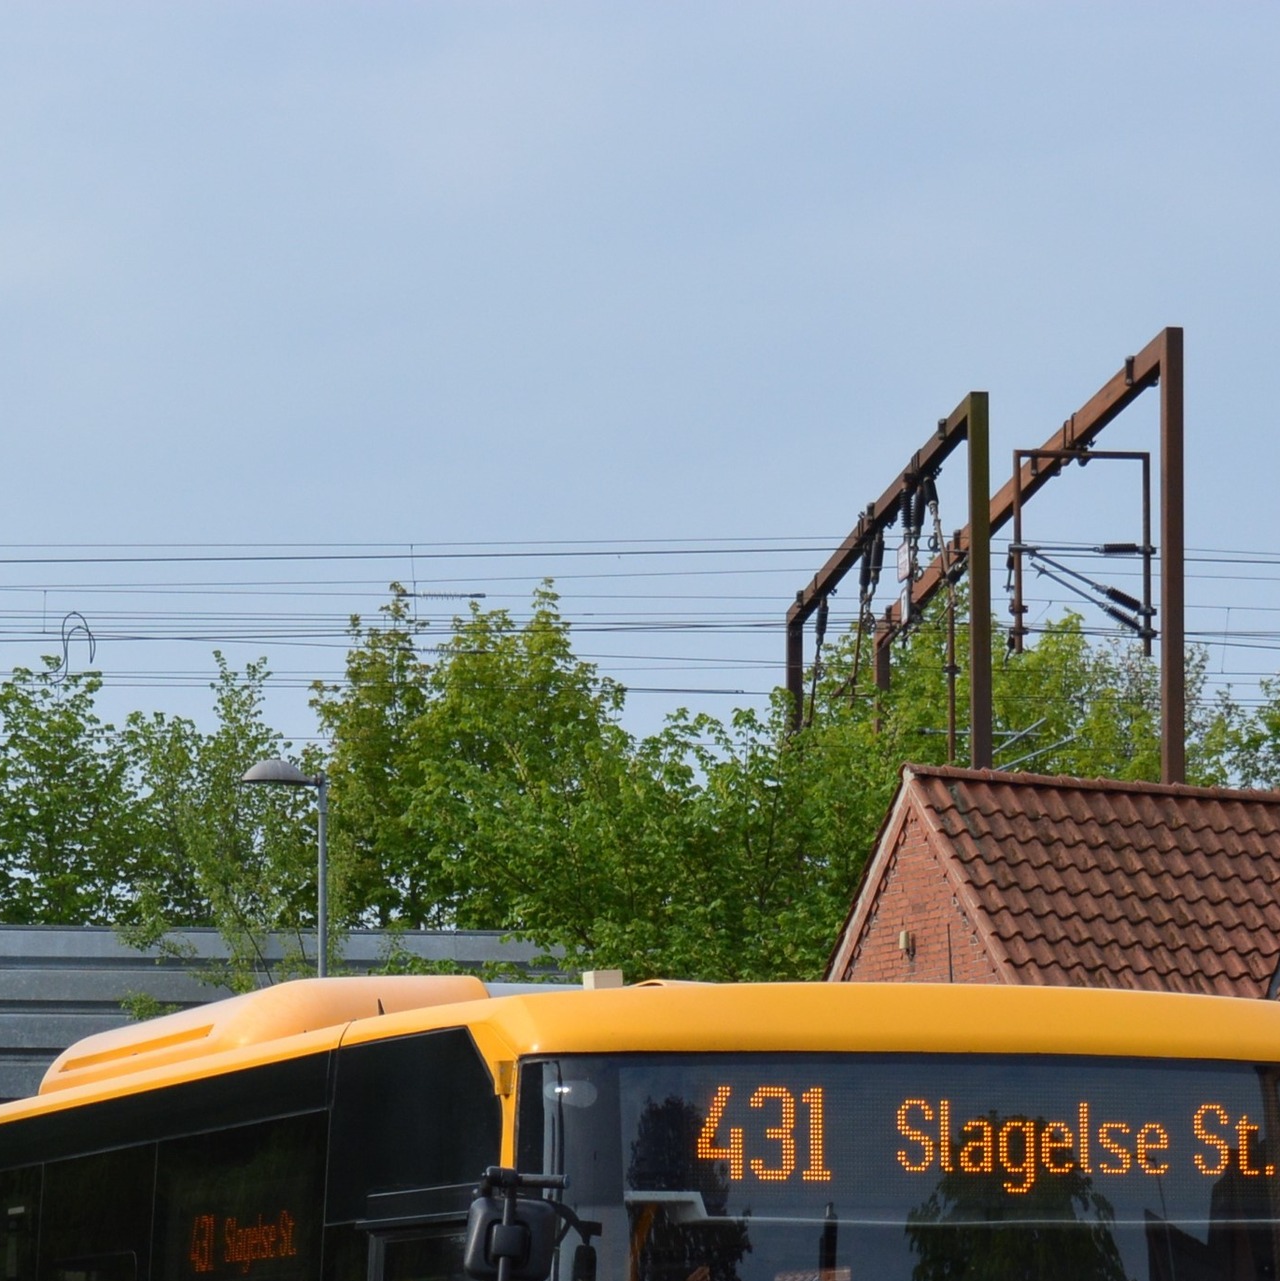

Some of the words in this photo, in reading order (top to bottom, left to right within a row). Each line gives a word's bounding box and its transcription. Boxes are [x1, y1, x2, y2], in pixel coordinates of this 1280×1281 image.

[697, 1086, 832, 1181] 431
[896, 1098, 1169, 1194] Slagelse
[1193, 1103, 1275, 1177] St.
